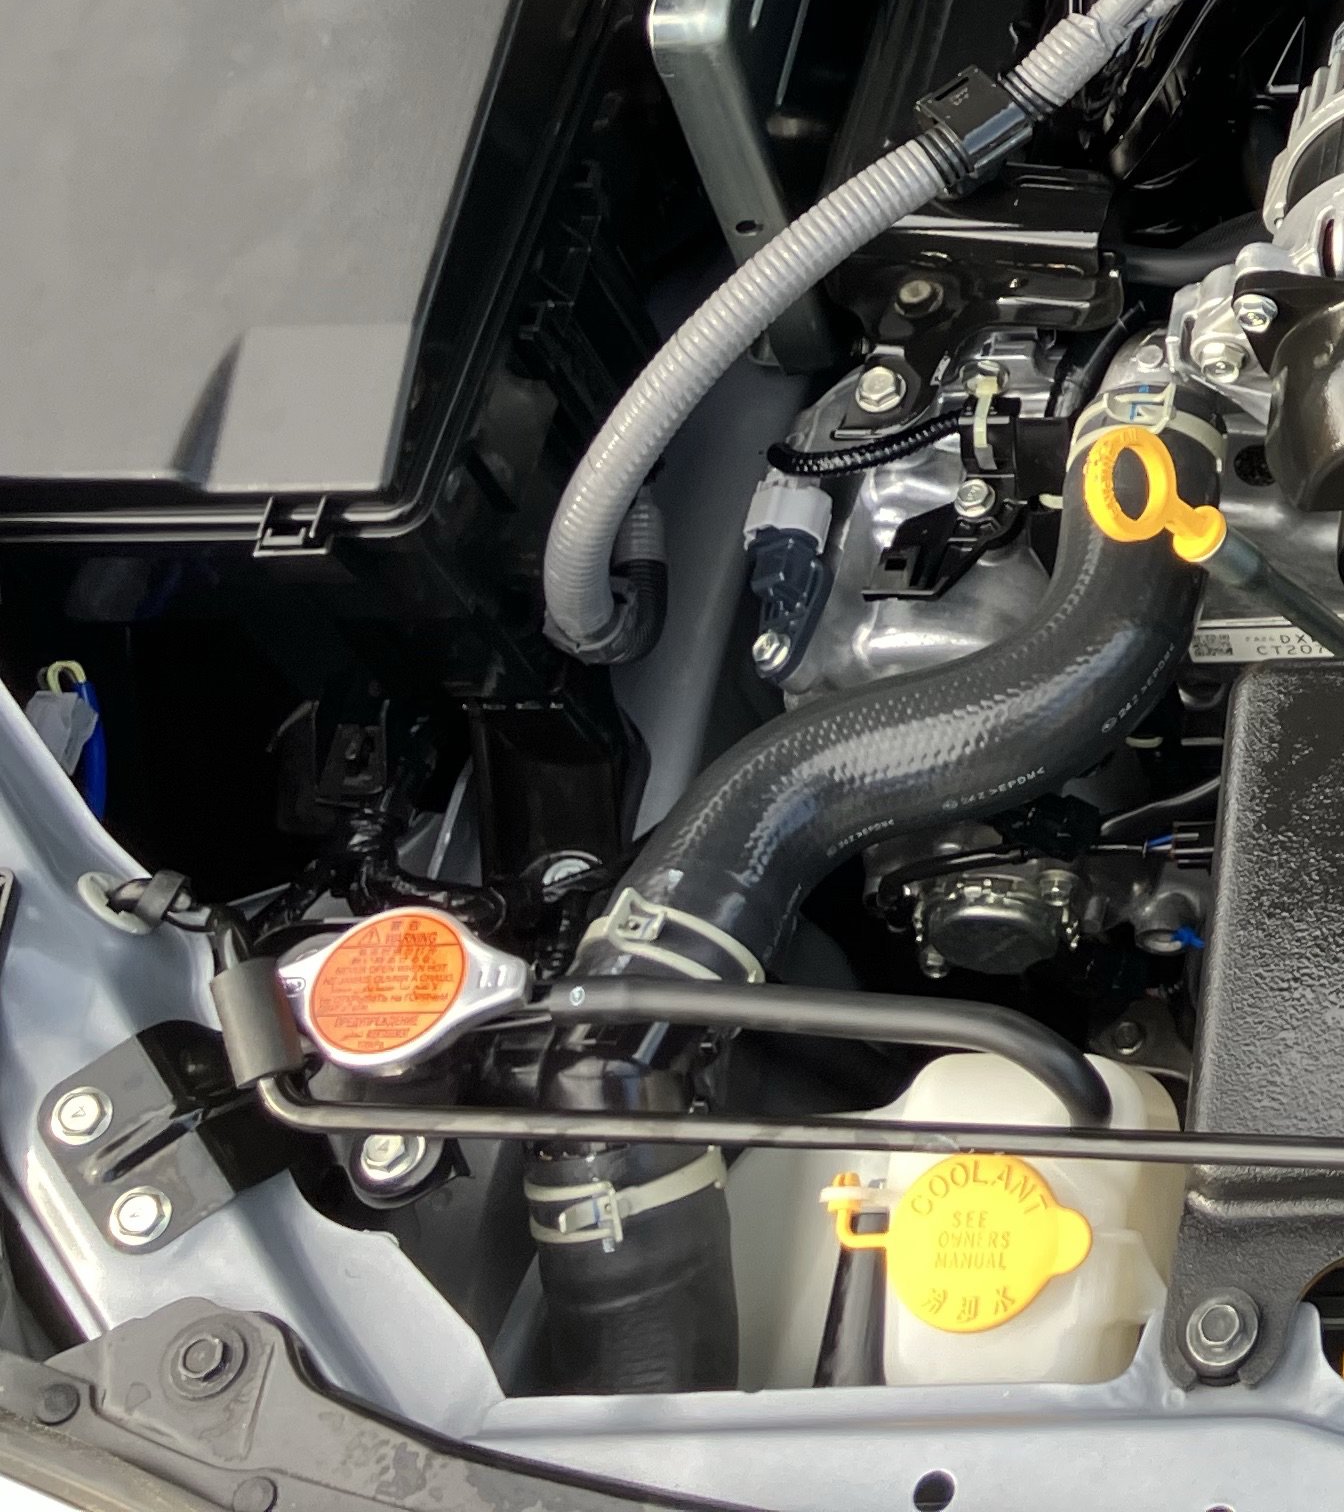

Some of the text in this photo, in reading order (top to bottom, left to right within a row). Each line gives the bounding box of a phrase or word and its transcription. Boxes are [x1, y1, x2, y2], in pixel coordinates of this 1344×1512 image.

[911, 1158, 1049, 1217] COOLANT
[951, 1210, 989, 1228] SEE
[937, 1231, 1012, 1249] OWNERS
[934, 1251, 1008, 1271] MANUAL
